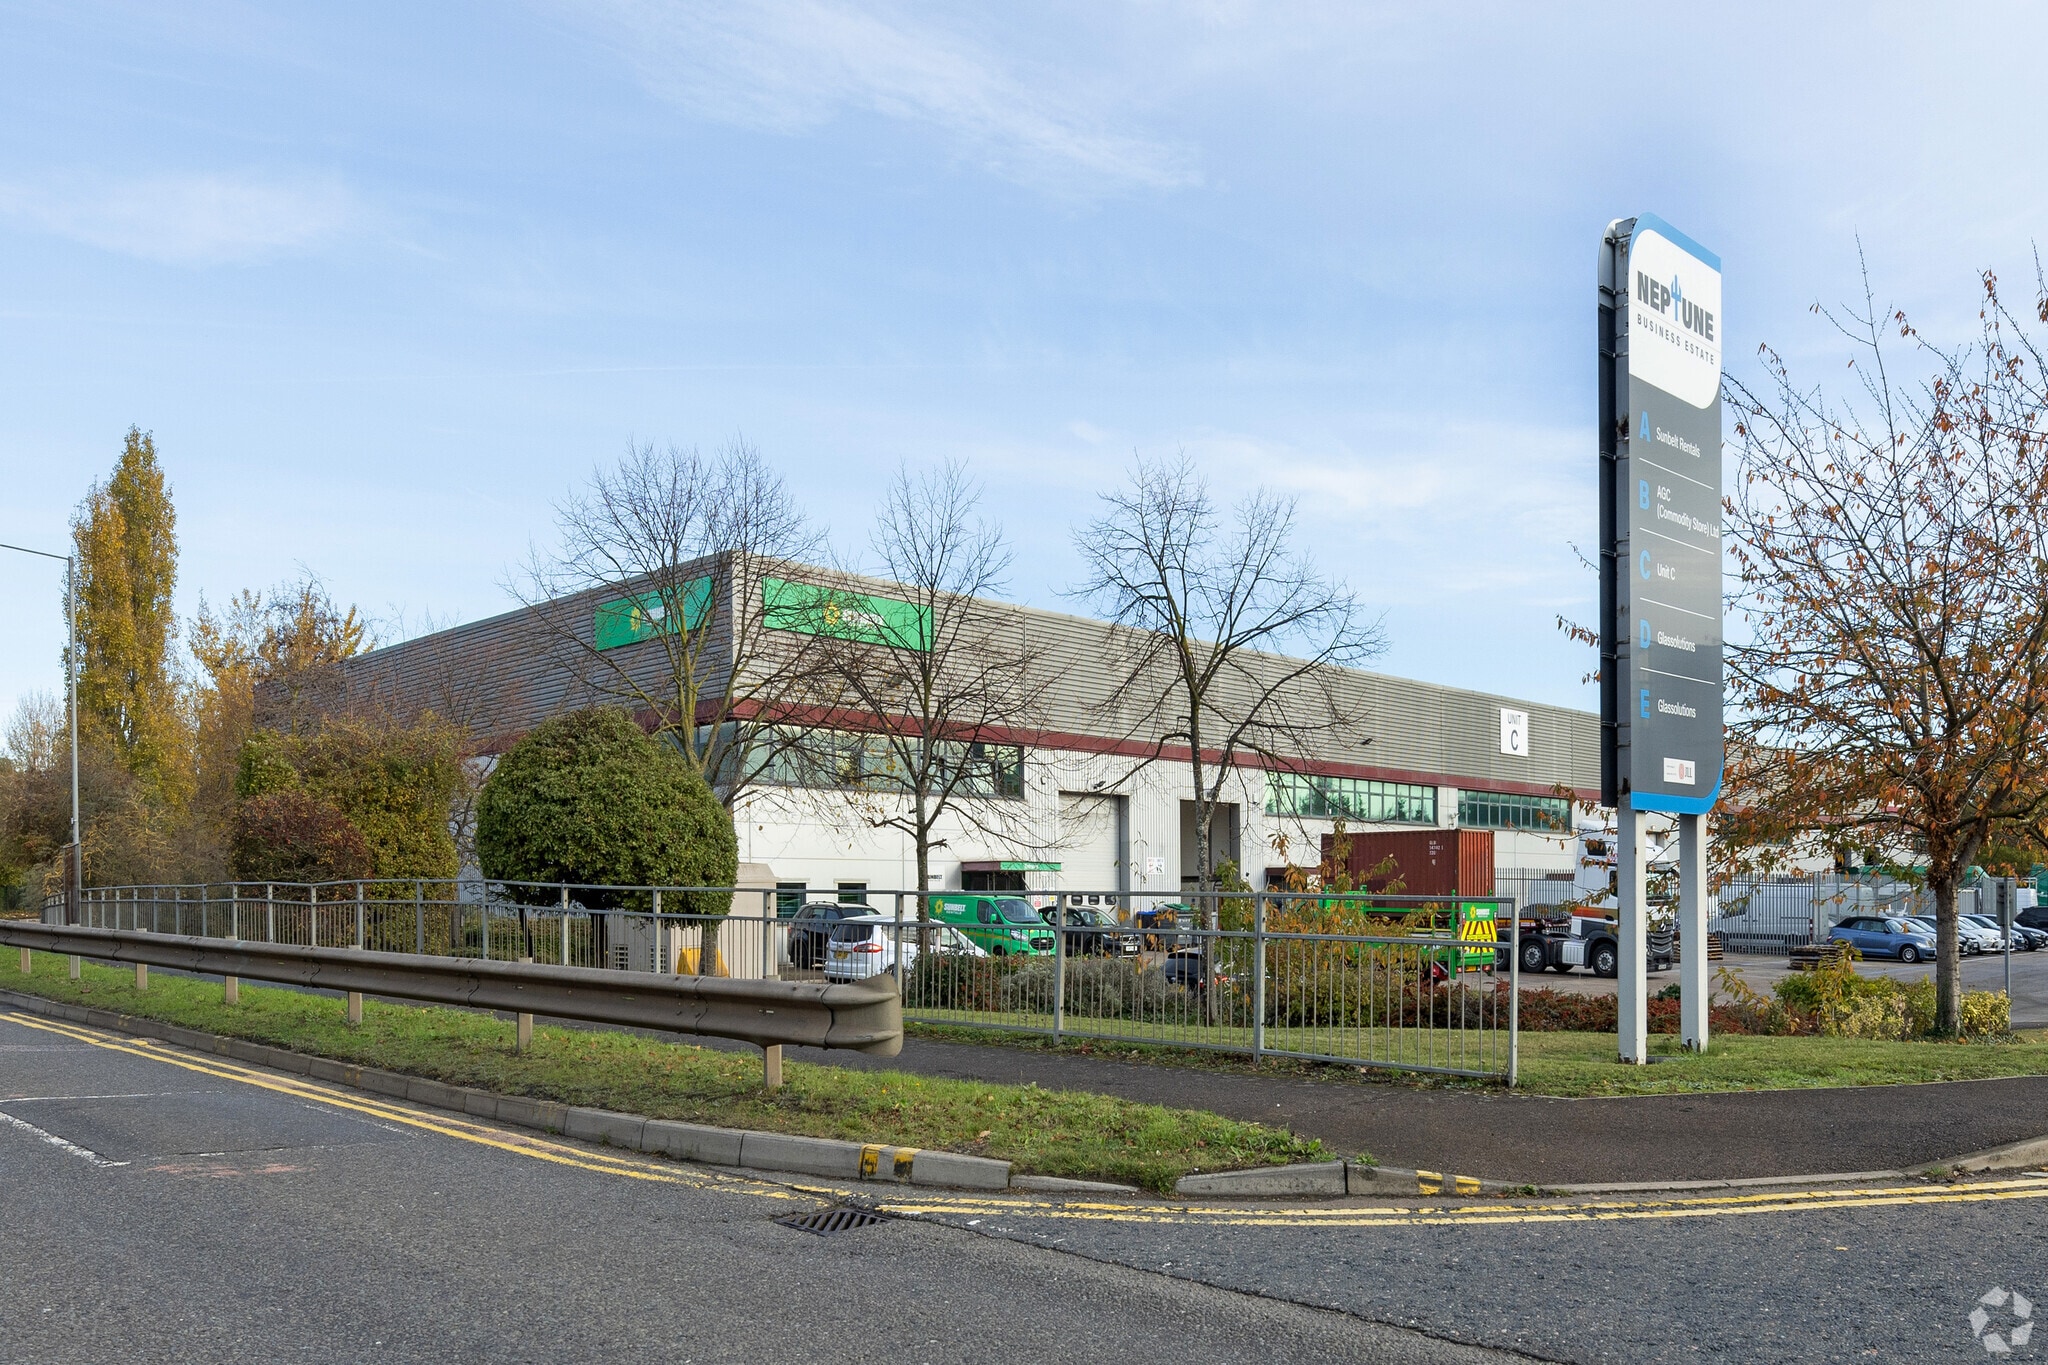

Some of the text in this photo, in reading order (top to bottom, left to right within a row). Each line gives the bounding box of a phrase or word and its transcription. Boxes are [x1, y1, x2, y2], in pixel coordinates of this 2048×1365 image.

[1637, 270, 1714, 343] NEPTUNE
[1637, 313, 1714, 365] BUSINESS ESTATE
[1640, 410, 1701, 458] A Sunbelt Rentals
[1640, 480, 1671, 510] B AGC
[1656, 503, 1720, 539] (Commodity Store) Ltd
[1640, 550, 1676, 581] C Unit C
[1640, 619, 1696, 653] D Glassolutions
[1640, 688, 1697, 719] E Glassolutions
[1507, 713, 1521, 726] UNIT
[1510, 729, 1519, 751] C
[944, 903, 966, 911] SUNBELT
